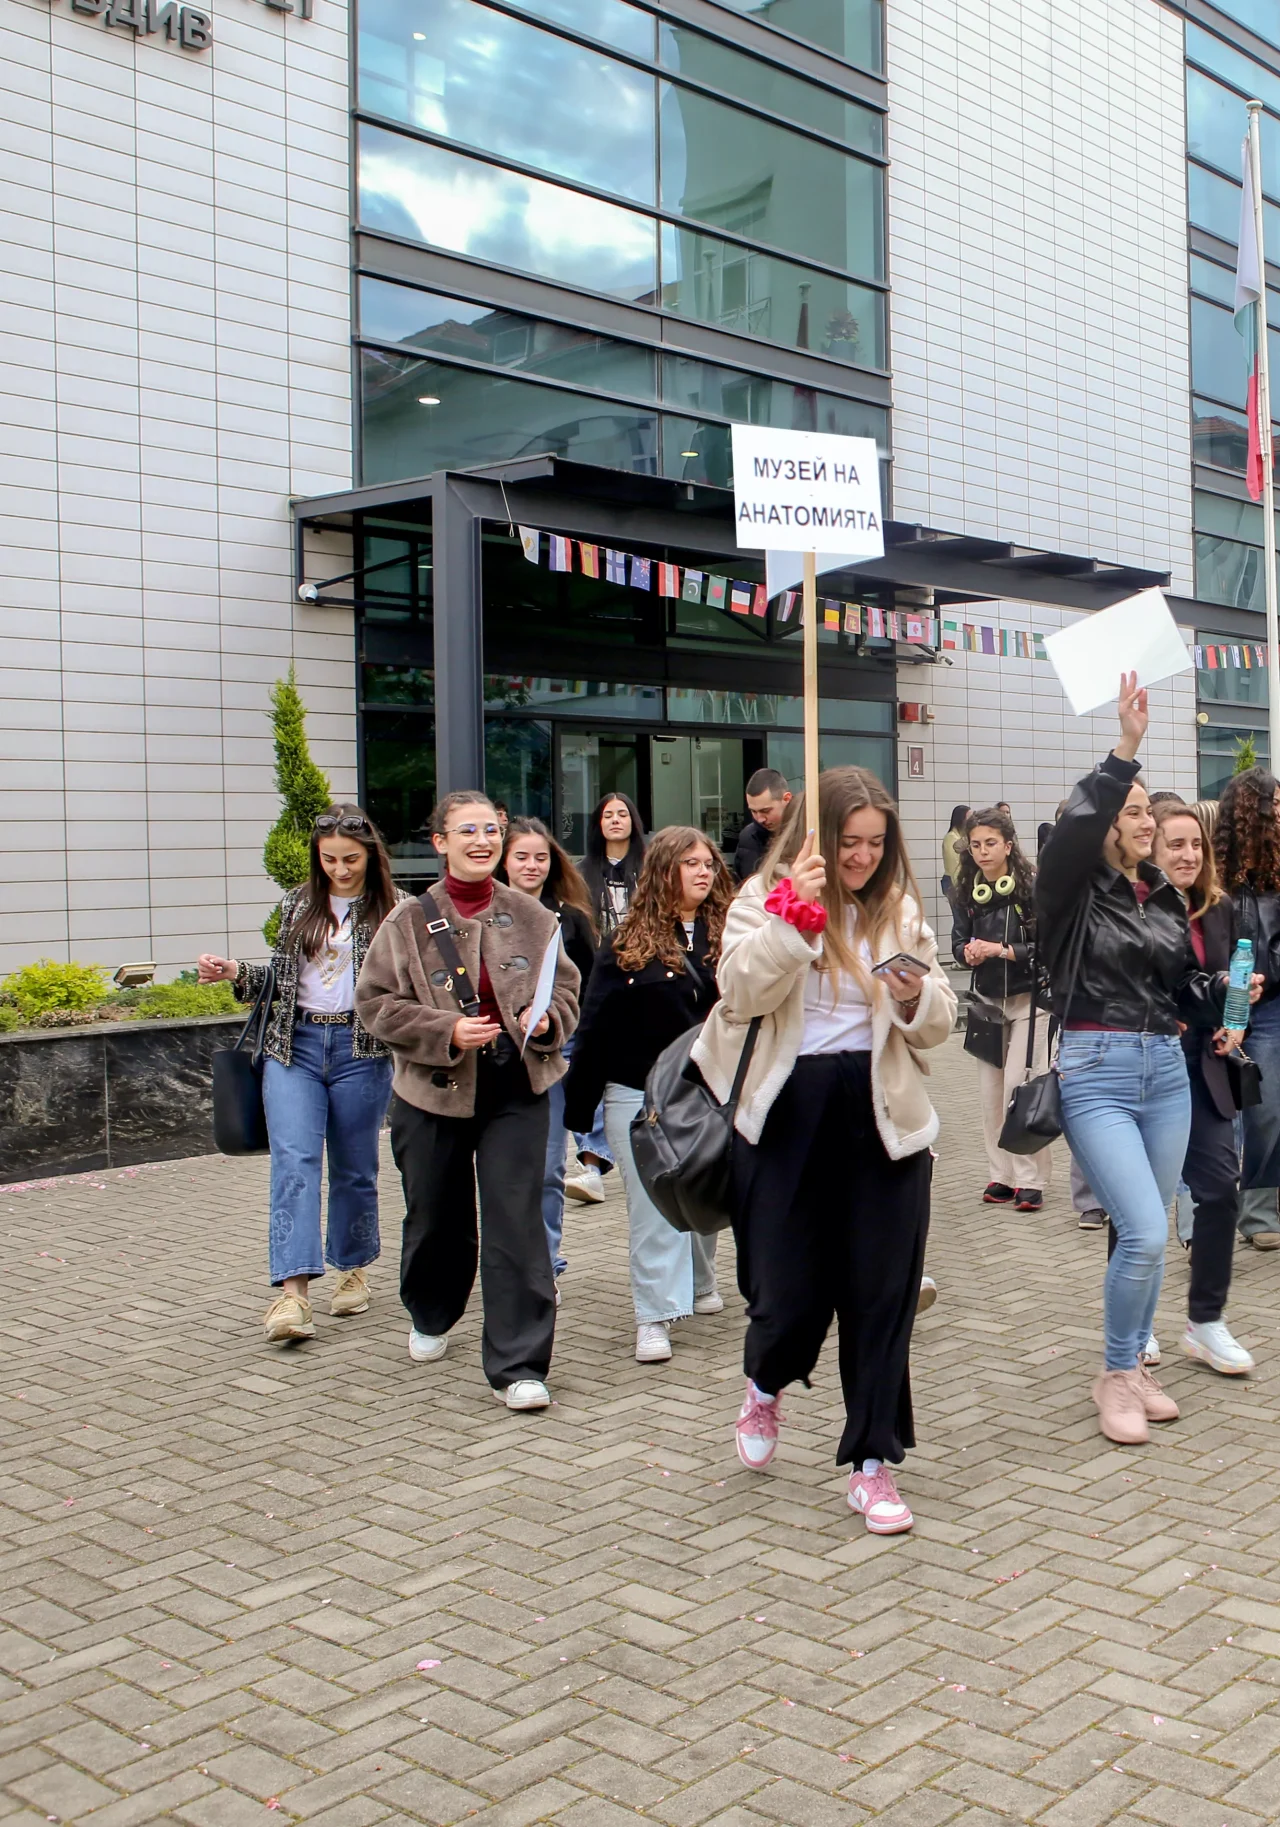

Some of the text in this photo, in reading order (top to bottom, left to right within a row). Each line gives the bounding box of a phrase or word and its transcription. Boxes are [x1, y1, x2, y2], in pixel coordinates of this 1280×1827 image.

[753, 456, 861, 485] МУЗЕЙ НА
[738, 501, 880, 532] АНАТОМИЯТА
[913, 761, 920, 773] 4
[311, 1013, 349, 1024] GUESS
